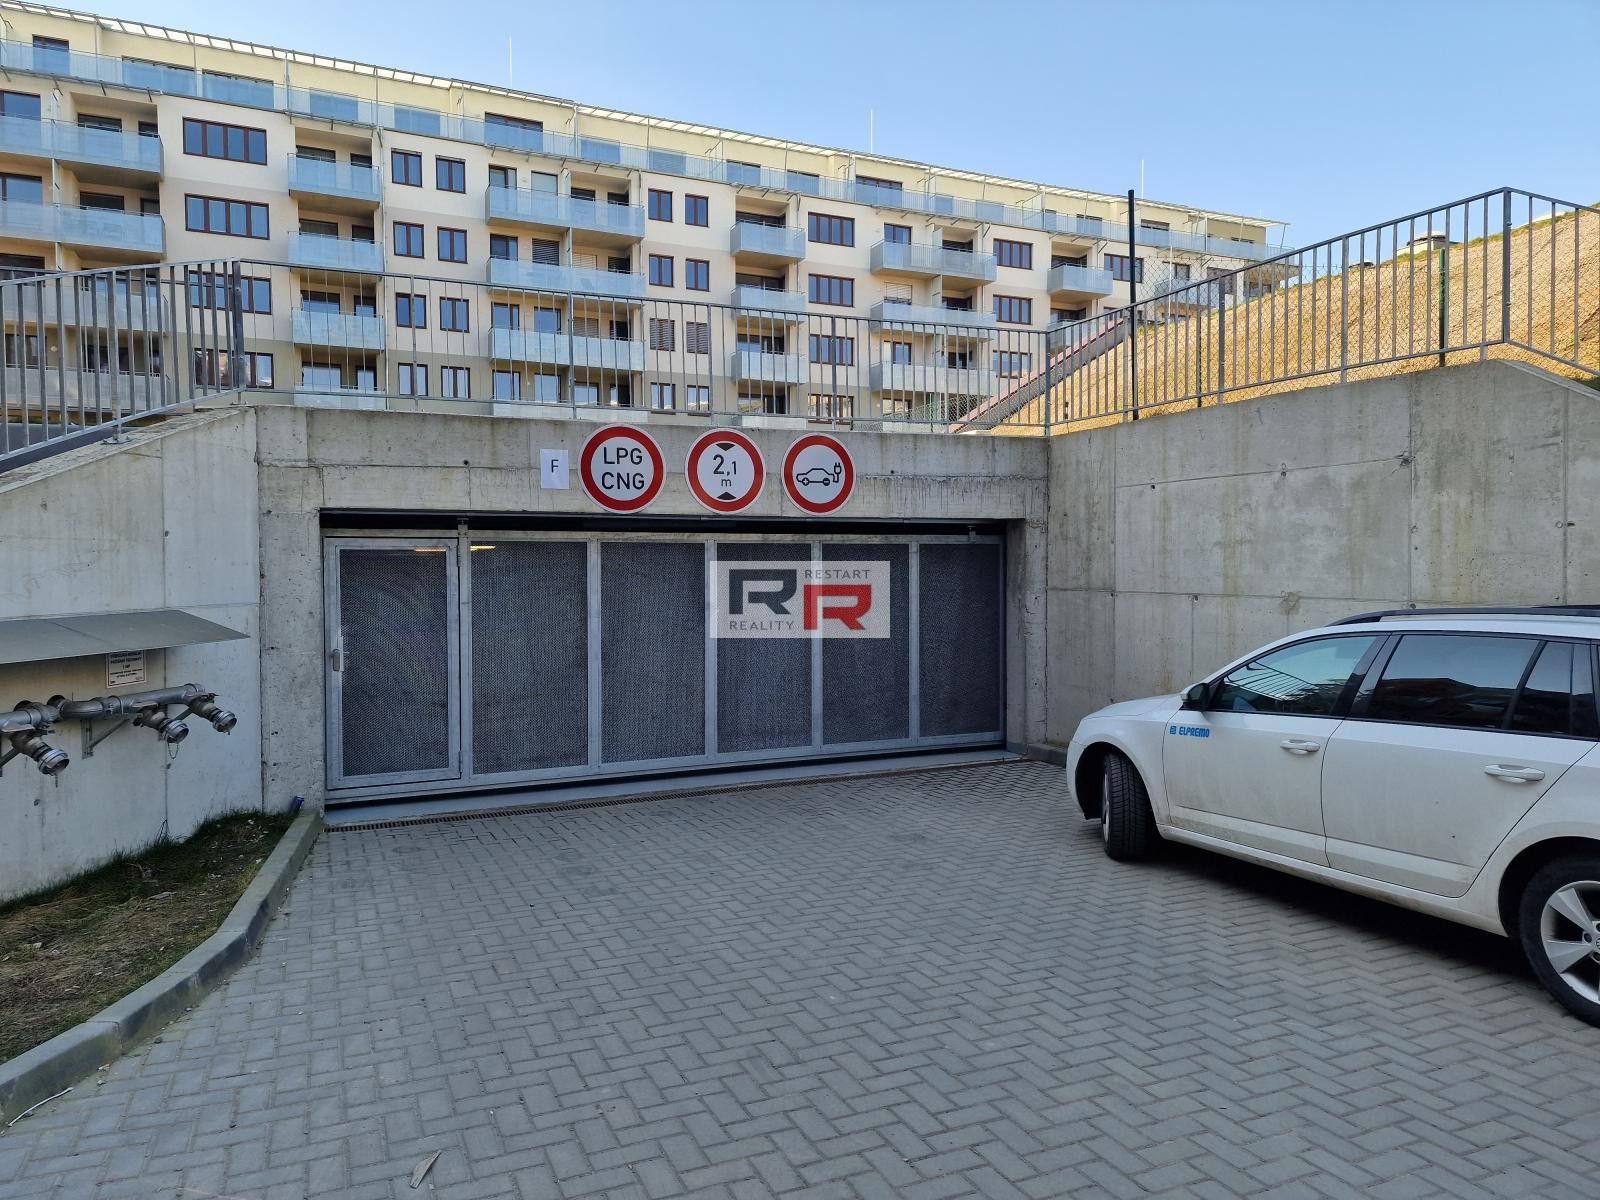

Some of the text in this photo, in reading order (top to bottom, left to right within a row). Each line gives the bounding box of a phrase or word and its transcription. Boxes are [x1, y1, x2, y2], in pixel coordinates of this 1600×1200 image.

[603, 446, 643, 465] LPG
[551, 459, 559, 473] F
[713, 454, 737, 477] 2,1
[601, 472, 645, 490] CNG
[721, 479, 732, 487] m
